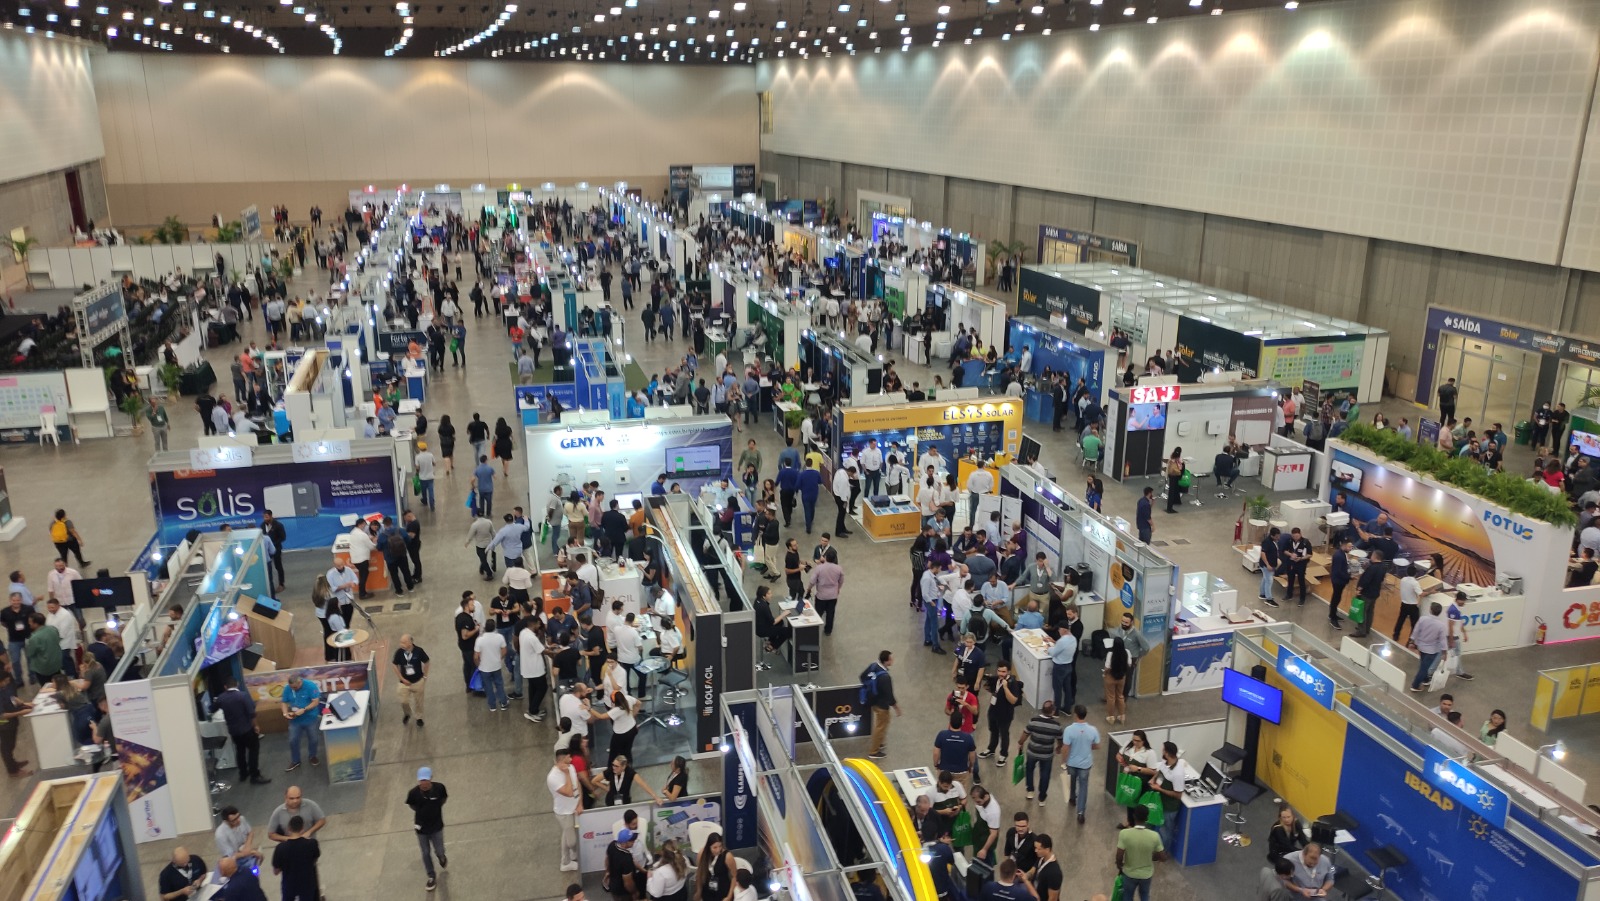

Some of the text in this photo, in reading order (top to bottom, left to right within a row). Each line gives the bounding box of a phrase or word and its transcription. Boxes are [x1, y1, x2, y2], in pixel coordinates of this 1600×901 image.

[1452, 317, 1482, 334] SAÍDA
[943, 409, 1014, 421] ELSYS SOLAR
[560, 436, 605, 449] GENYX
[176, 487, 256, 521] solis
[1483, 510, 1534, 541] FOTUS
[1460, 611, 1504, 626] OTUS
[1404, 770, 1454, 811] IBRAP
